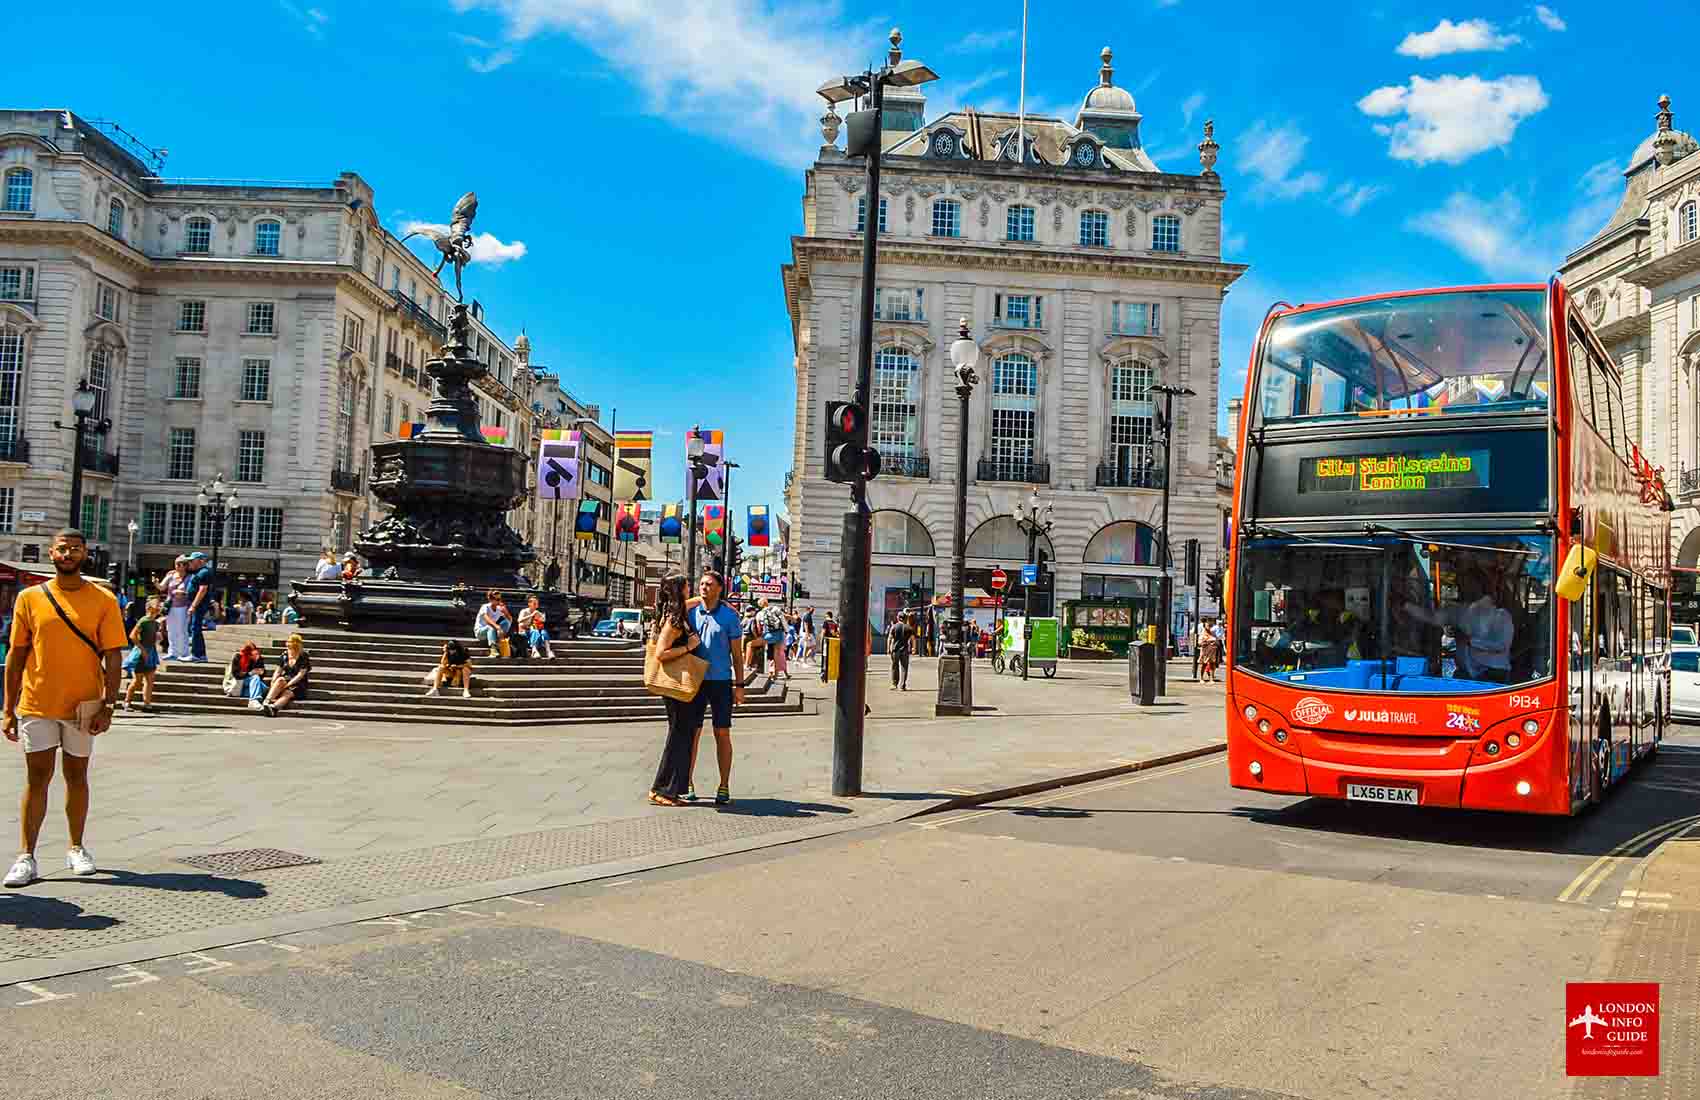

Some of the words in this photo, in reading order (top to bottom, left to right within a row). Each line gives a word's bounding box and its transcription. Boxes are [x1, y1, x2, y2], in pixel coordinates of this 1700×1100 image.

[1317, 459, 1355, 477] City
[1360, 453, 1472, 474] Sightseeing
[1360, 473, 1426, 490] London
[1509, 695, 1540, 709] 19134
[1295, 705, 1334, 719] OFFICIAL
[1390, 711, 1418, 724] TRAVEL
[1446, 712, 1465, 729] 24
[1352, 786, 1385, 800] LX56
[1388, 789, 1413, 802] EAK
